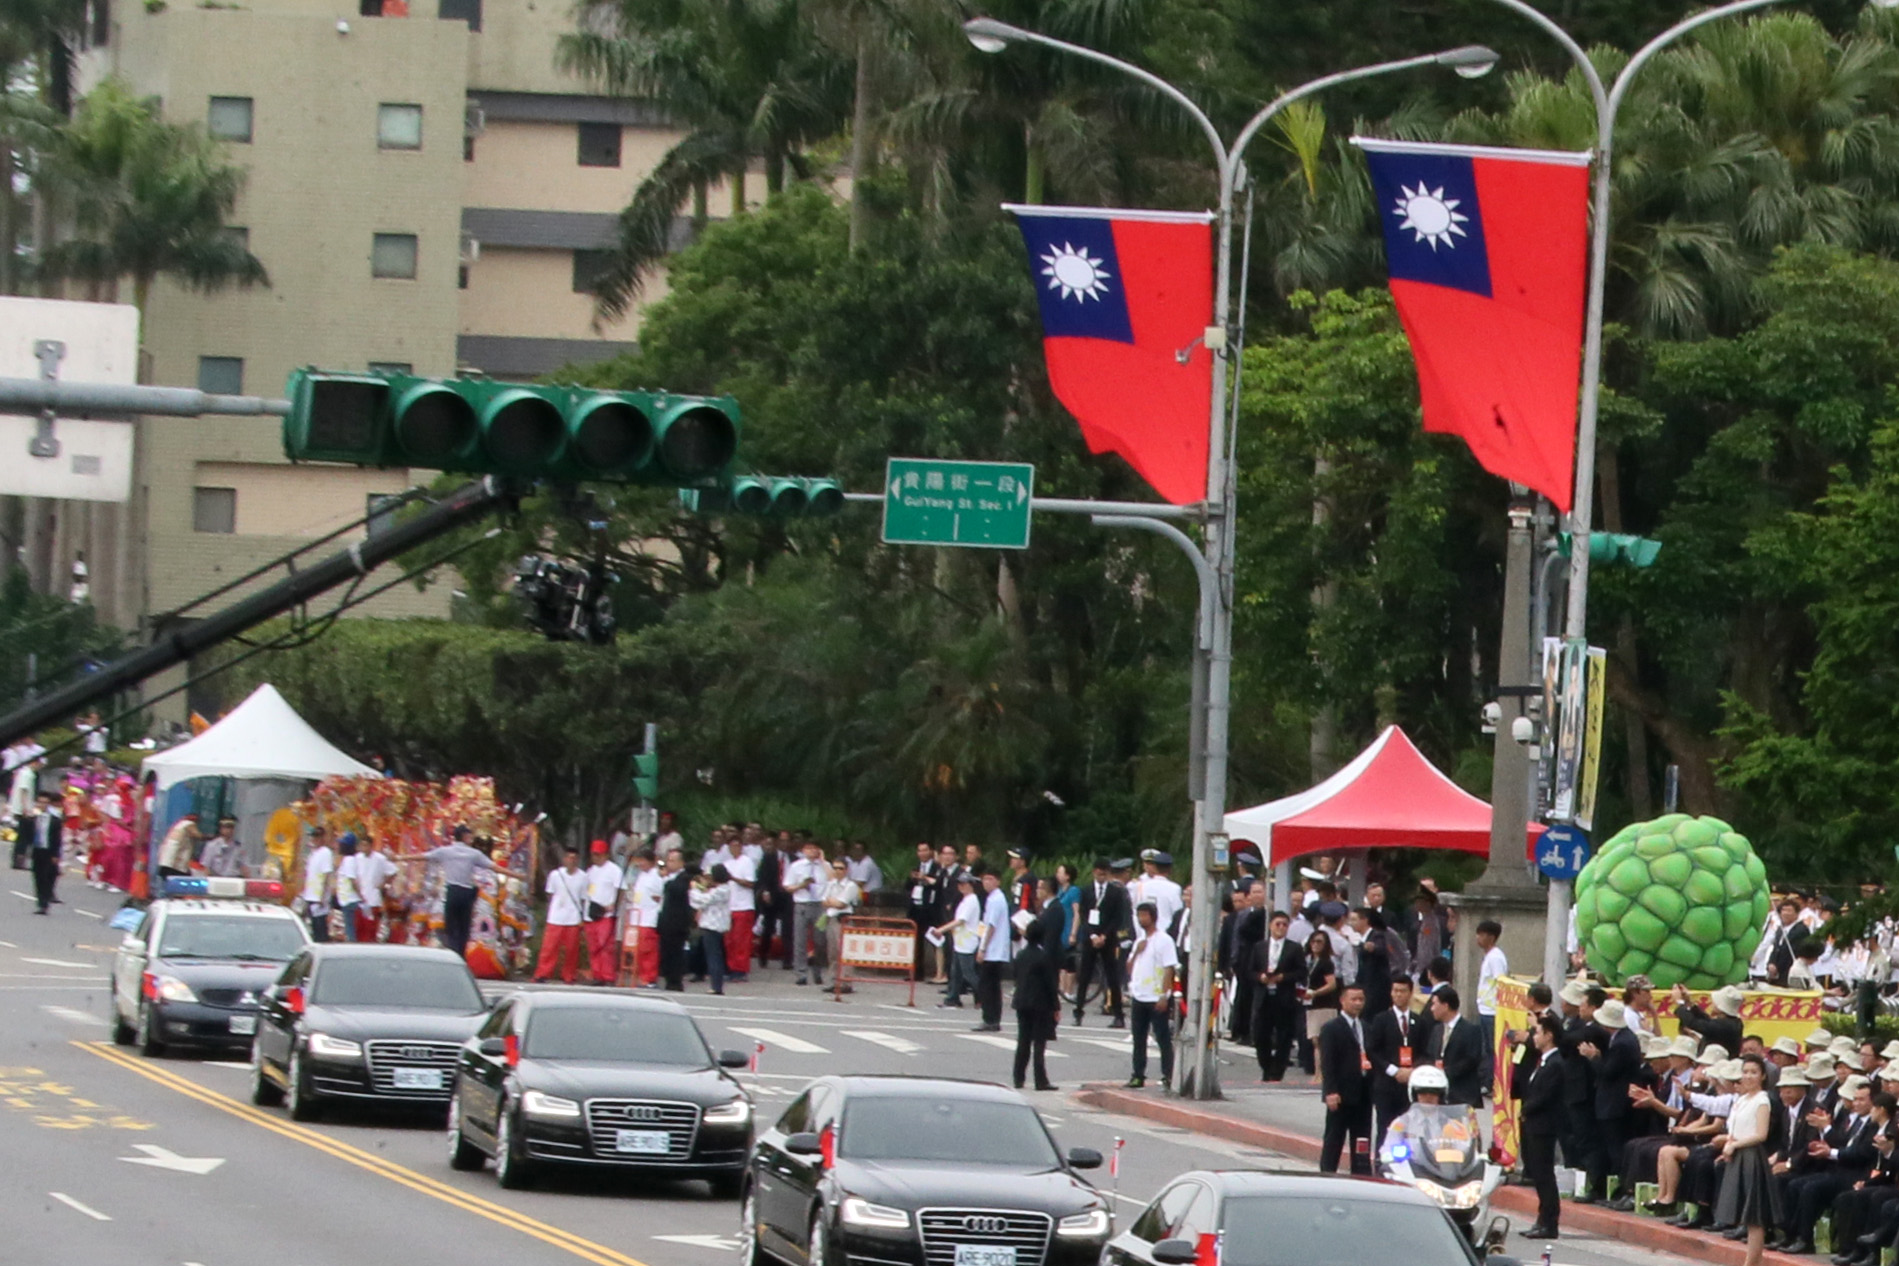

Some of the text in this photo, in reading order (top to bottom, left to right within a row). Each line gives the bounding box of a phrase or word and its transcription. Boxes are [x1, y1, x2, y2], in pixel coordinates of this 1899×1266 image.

[903, 471, 1016, 493] 貴陽街一段
[1006, 500, 1013, 511] 1
